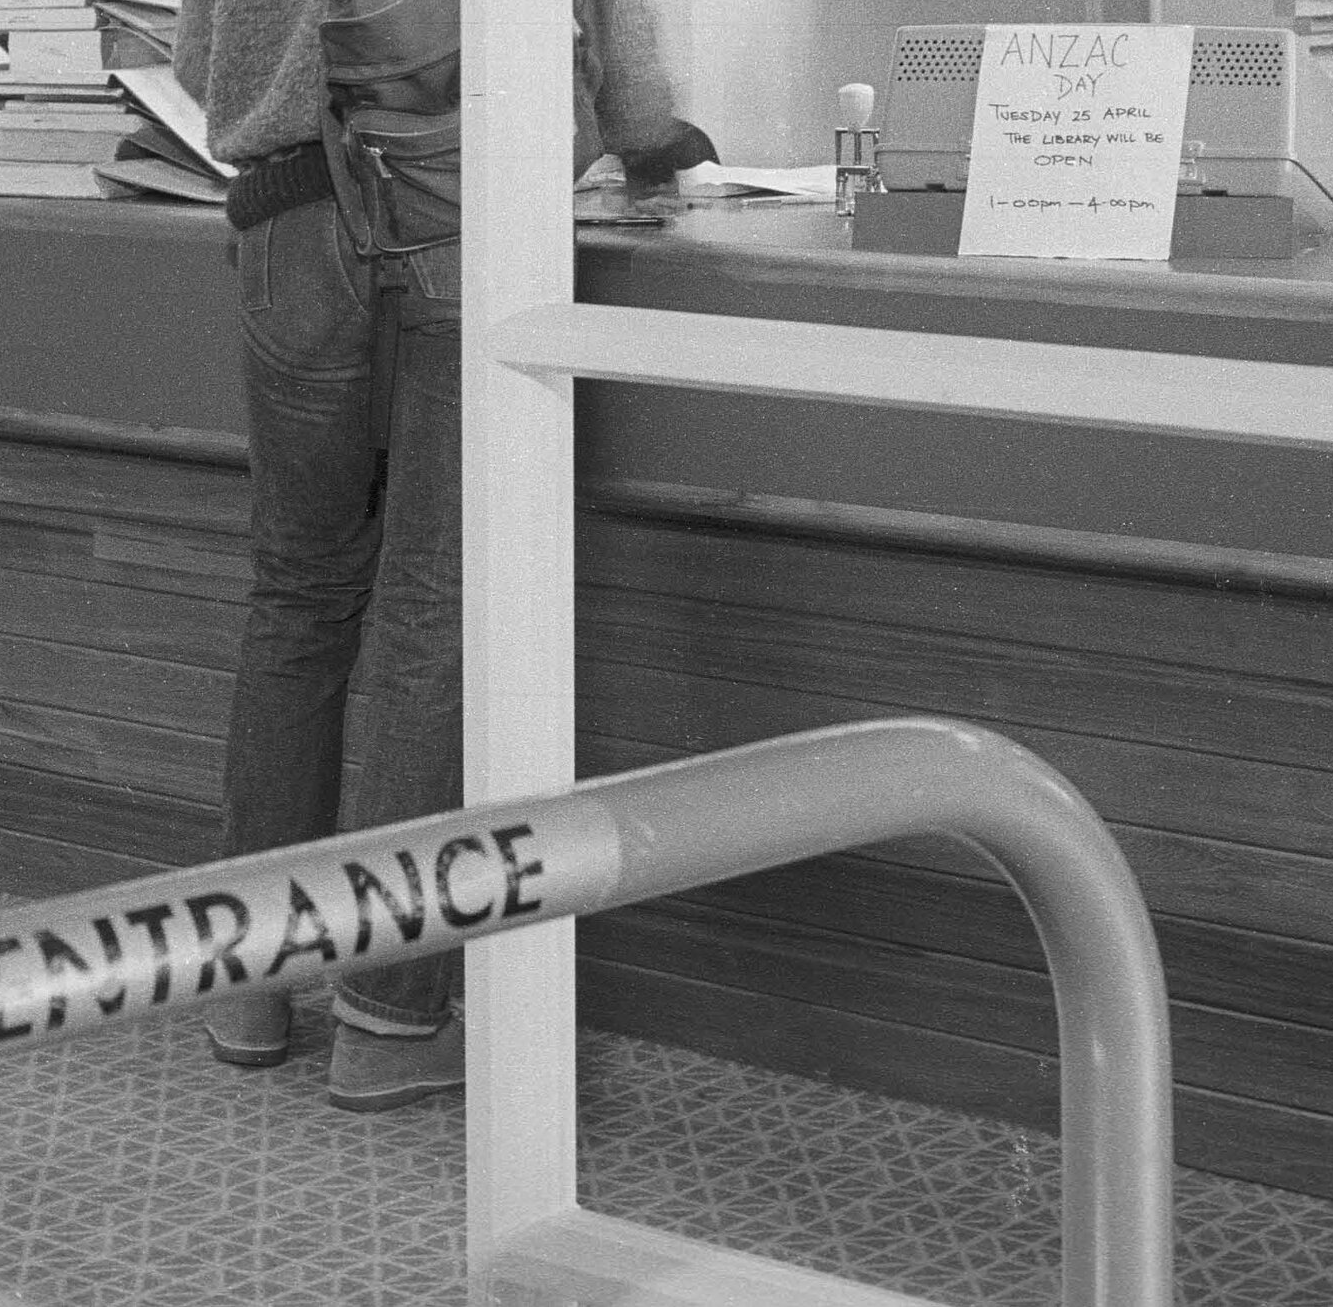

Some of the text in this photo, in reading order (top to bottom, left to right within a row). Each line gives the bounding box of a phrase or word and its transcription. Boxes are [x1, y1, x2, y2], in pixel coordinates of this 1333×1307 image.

[1000, 33, 1130, 69] ANZAC
[1053, 72, 1104, 101] DAY
[988, 103, 1153, 126] TUESDAY 25 APRIL
[1003, 131, 1165, 149] THE LIBRARY WILL BE
[1033, 154, 1094, 167] OPEN
